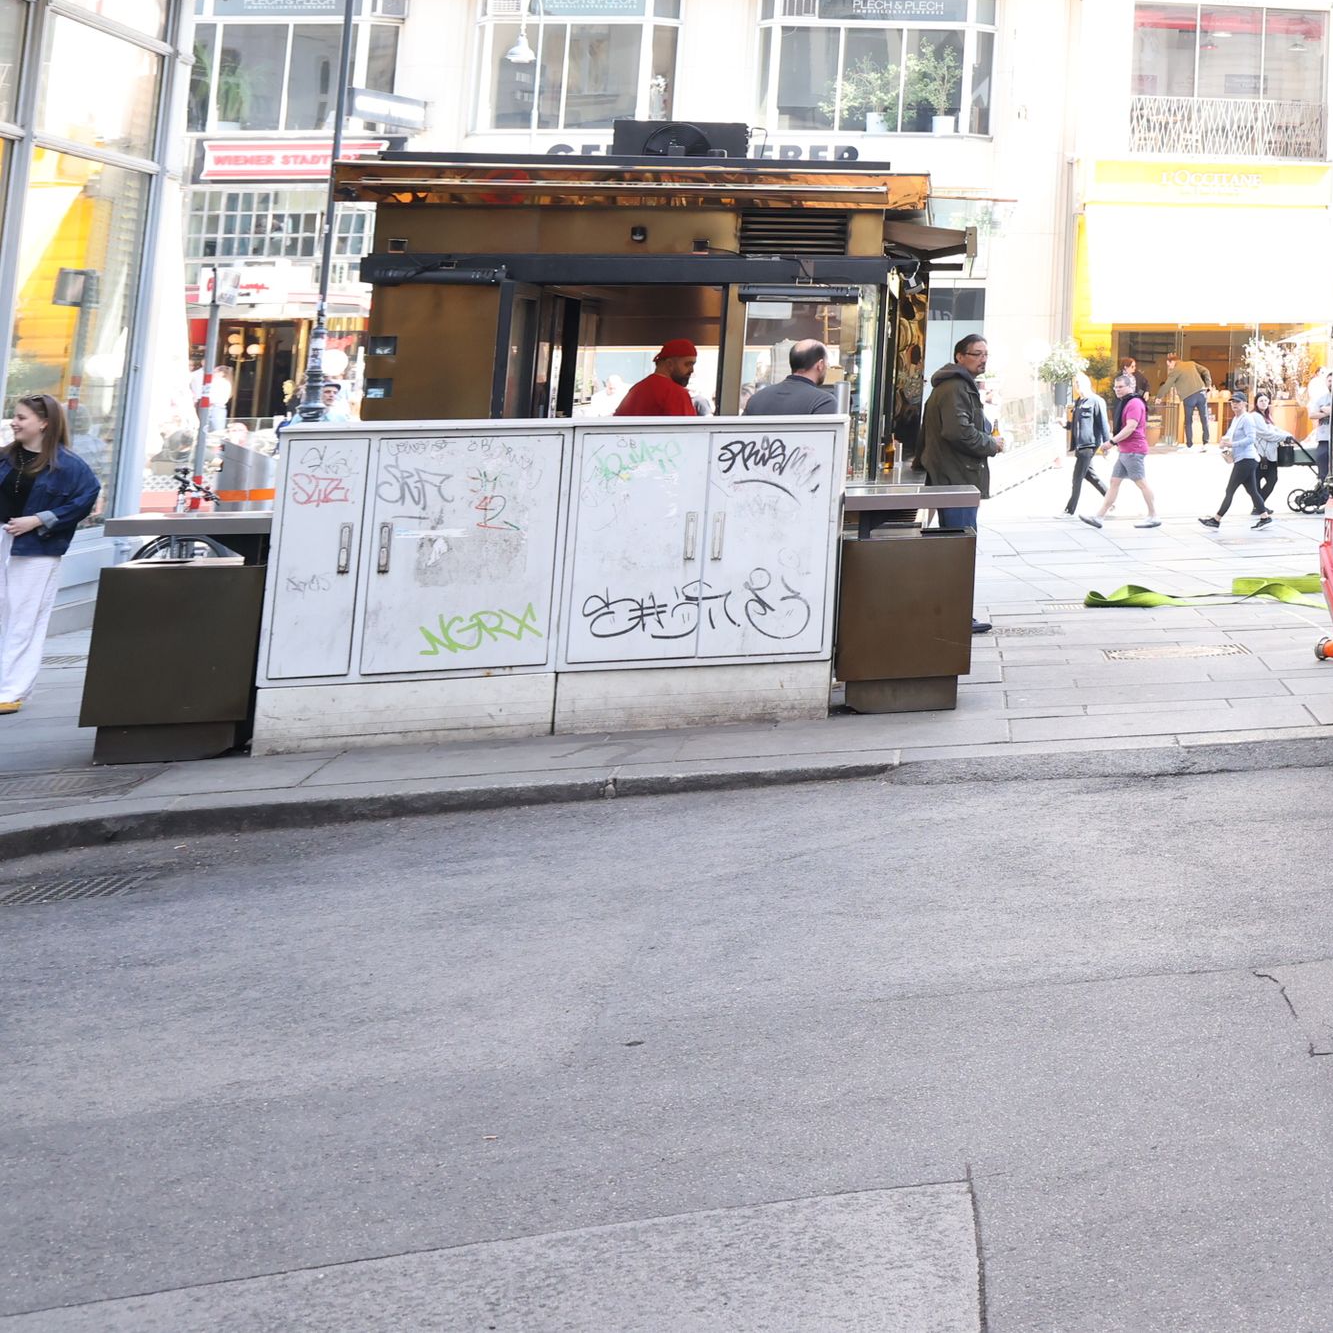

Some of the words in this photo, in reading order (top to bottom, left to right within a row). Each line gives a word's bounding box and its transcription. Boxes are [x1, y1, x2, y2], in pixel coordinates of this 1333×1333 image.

[853, 0, 893, 10] PLECH
[905, 0, 944, 11] PLECH
[213, 153, 275, 165] WIENER
[1160, 169, 1263, 186] L'OCCITANE
